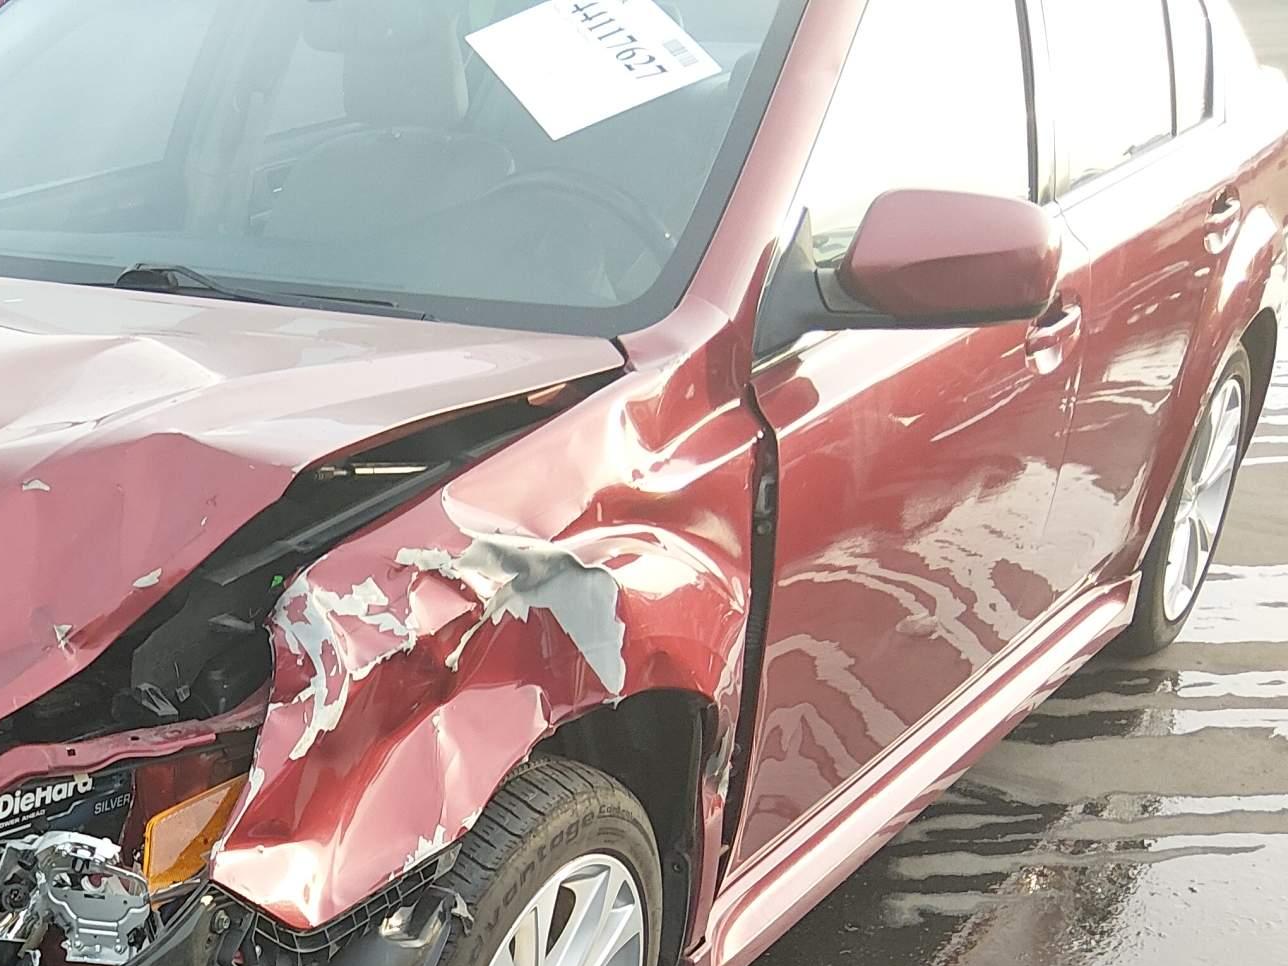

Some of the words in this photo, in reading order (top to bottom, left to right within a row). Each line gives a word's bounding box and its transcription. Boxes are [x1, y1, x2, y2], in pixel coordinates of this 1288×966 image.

[571, 1, 668, 80] 44117627
[94, 793, 131, 815] SILVER
[21, 809, 46, 822] AHEAD
